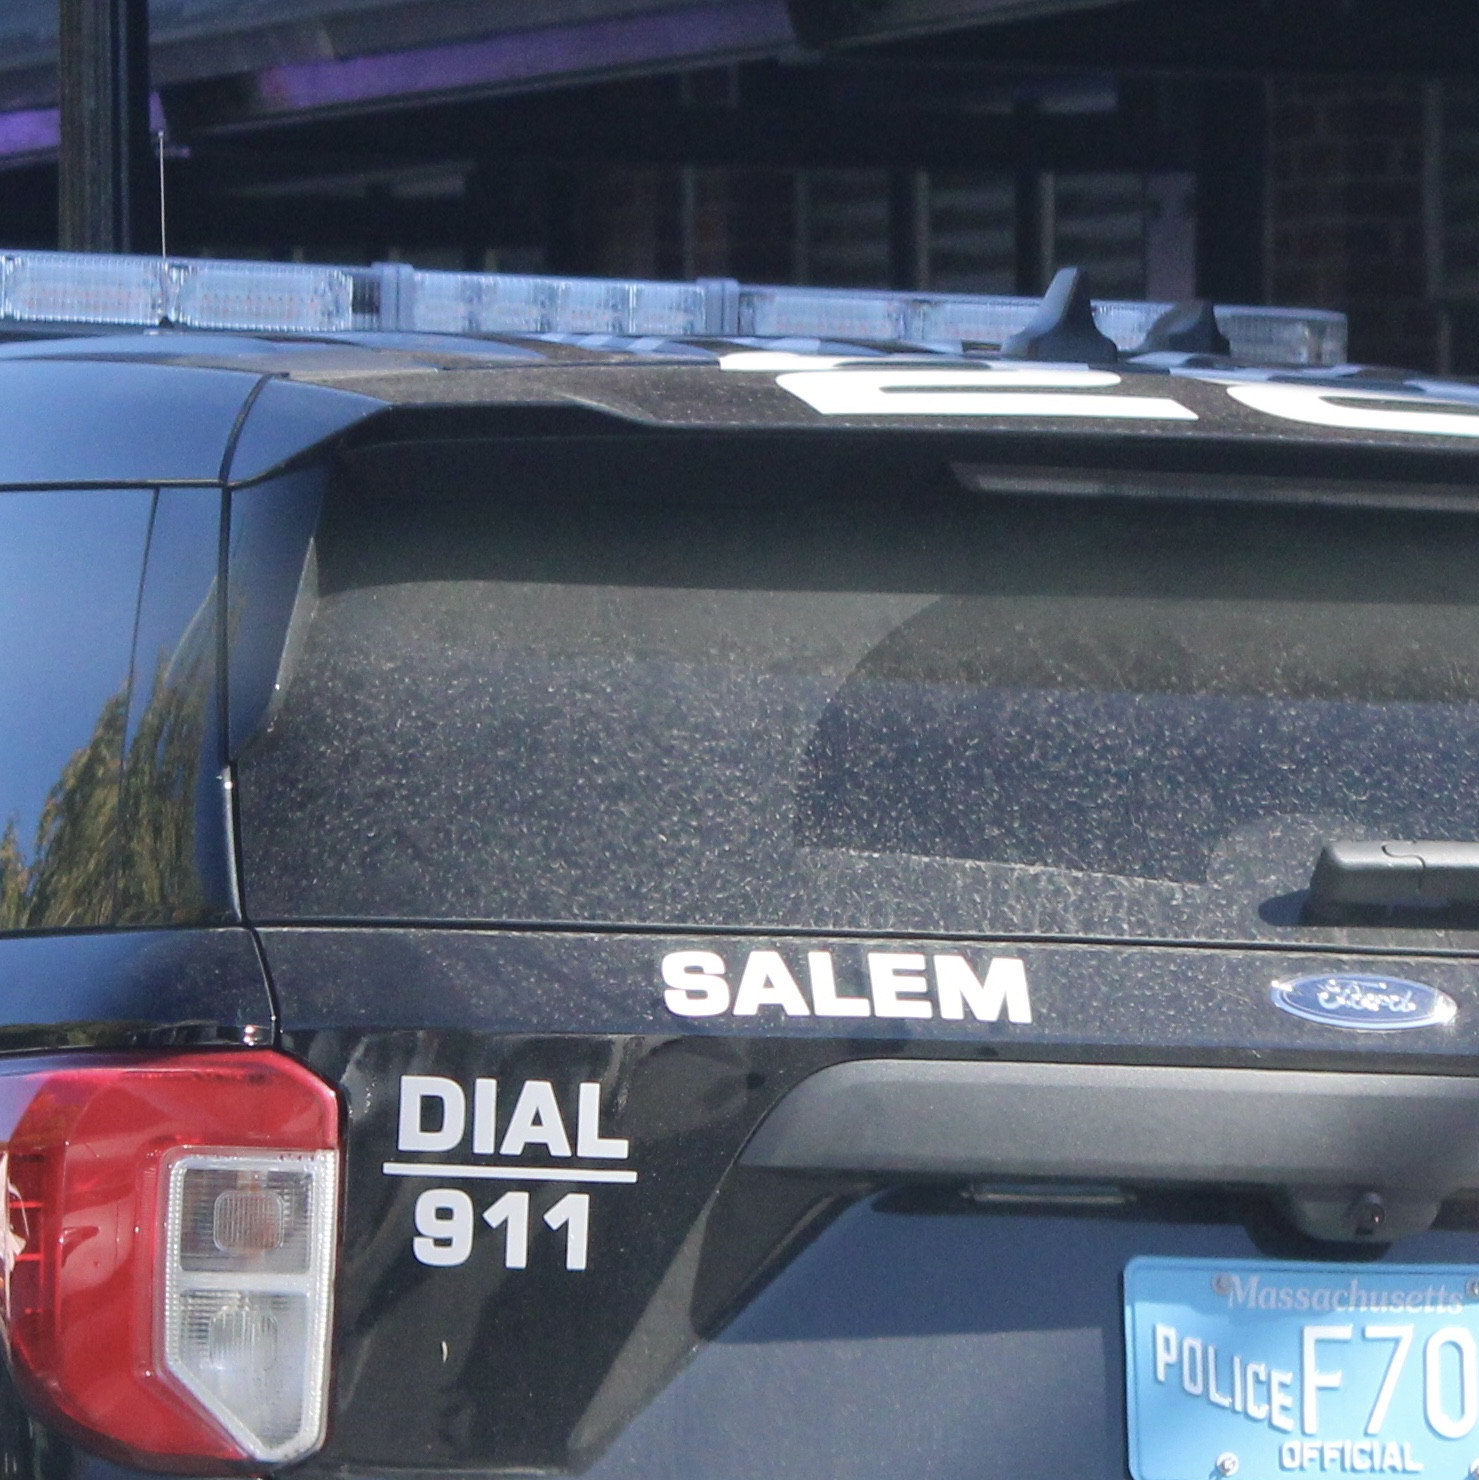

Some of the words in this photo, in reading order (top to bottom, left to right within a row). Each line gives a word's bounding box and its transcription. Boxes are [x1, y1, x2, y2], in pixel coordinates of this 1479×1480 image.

[660, 950, 1033, 1025] SALEM
[398, 1075, 629, 1159] DIAL
[413, 1188, 590, 1270] 911
[1228, 1273, 1465, 1317] Massachusetts
[1154, 1323, 1295, 1435] POLICE
[1281, 1438, 1424, 1474] OFFICIAL
